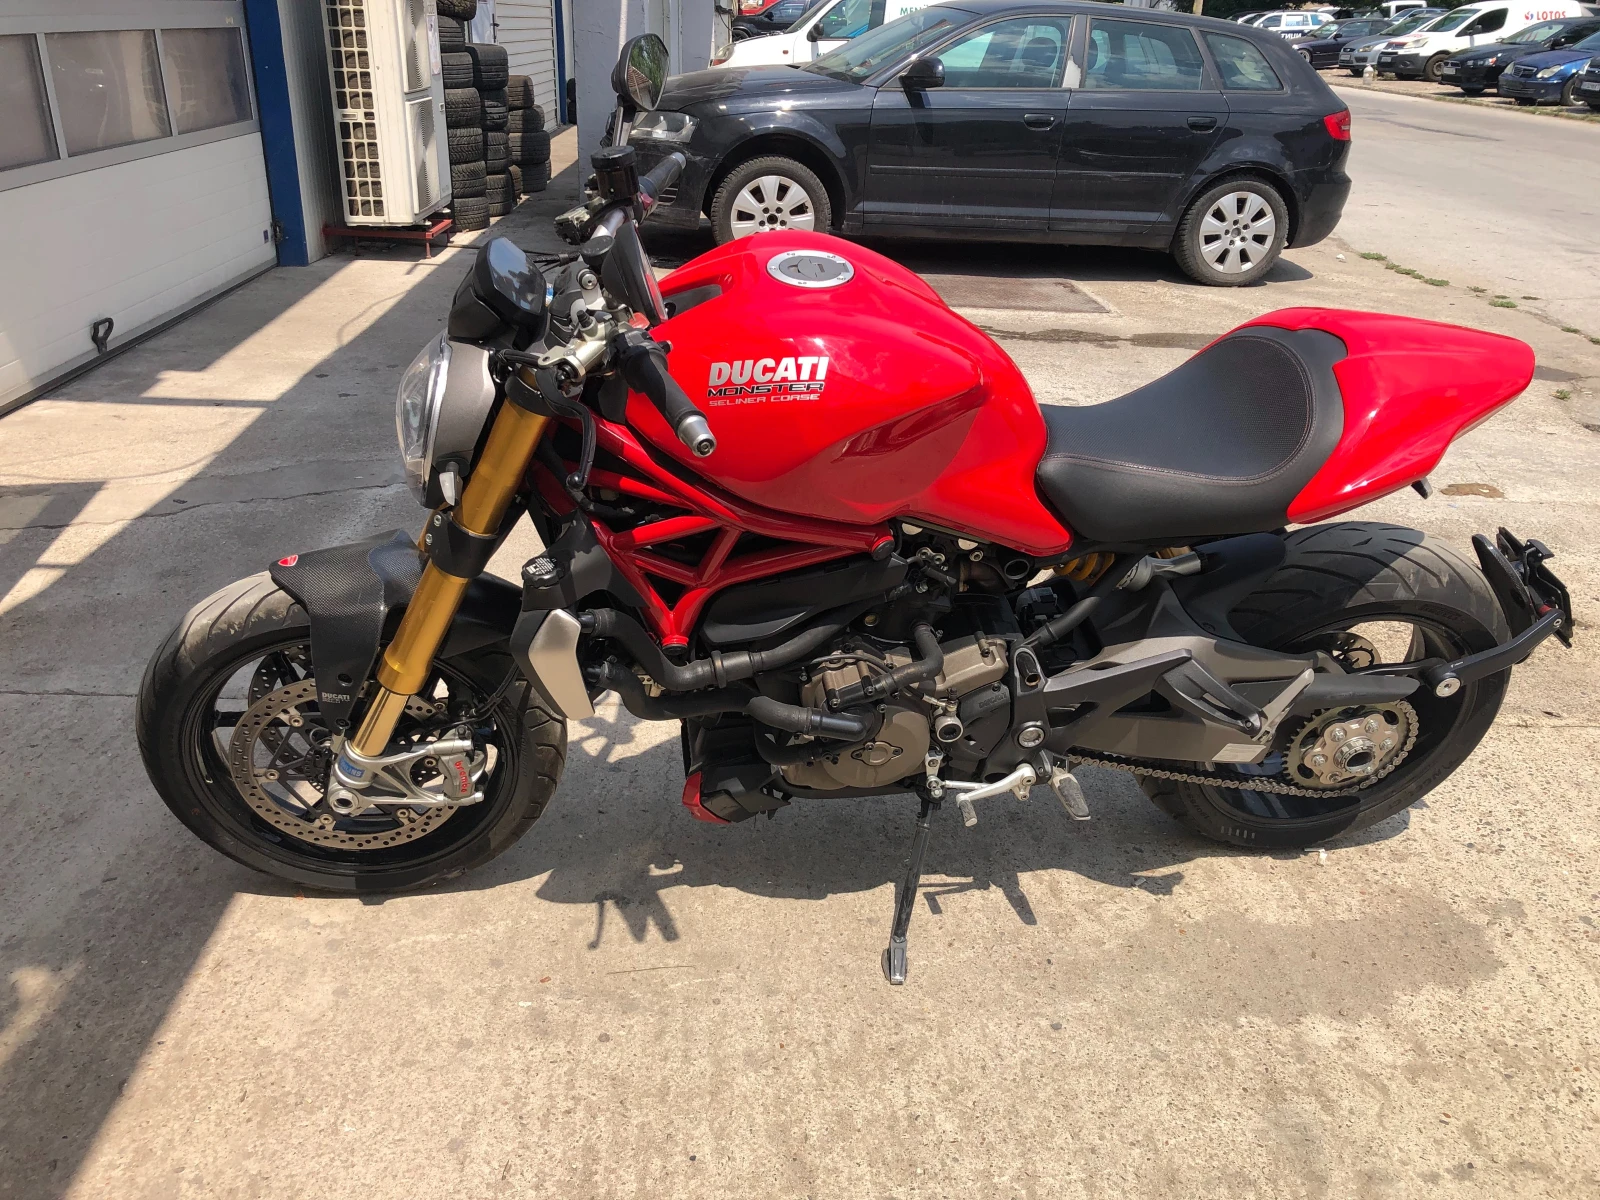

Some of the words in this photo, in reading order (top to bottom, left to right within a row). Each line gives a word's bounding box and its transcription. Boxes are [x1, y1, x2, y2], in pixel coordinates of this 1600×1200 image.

[1536, 11, 1566, 20] LOTOS
[708, 356, 829, 386] DUCATI
[707, 382, 825, 398] MONSTER
[770, 393, 820, 403] CORSE
[321, 692, 350, 700] DUCATI
[978, 692, 1007, 709] DUCATI
[454, 760, 471, 793] brembo
